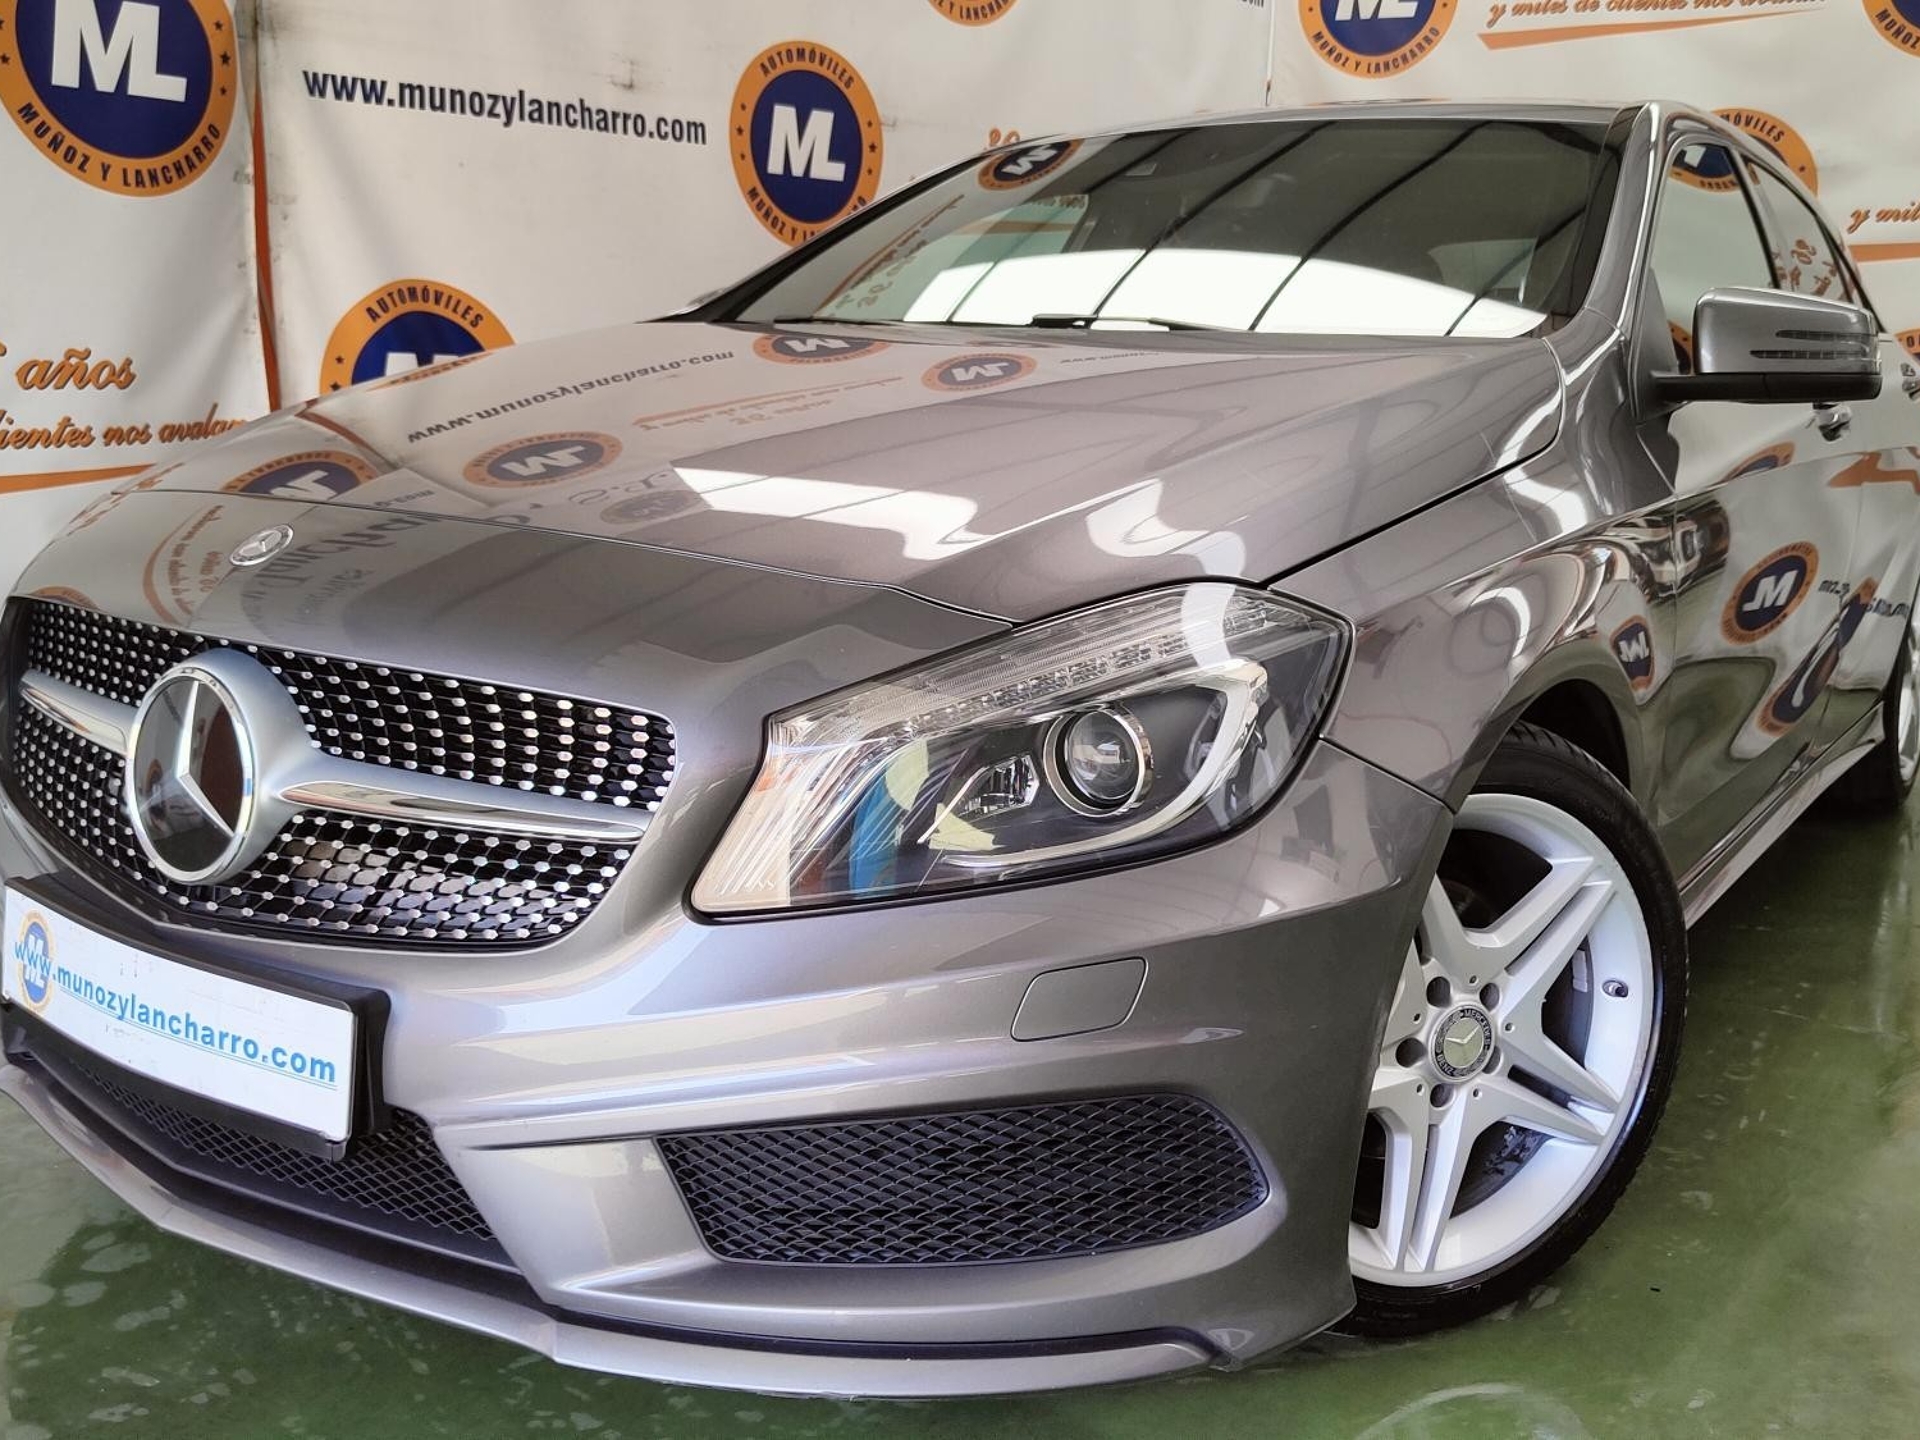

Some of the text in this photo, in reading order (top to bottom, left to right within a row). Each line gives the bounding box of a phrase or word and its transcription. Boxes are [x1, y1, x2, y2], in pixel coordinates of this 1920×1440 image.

[51, 0, 187, 102] ML
[759, 47, 855, 90] AUTOMÓVILES
[1312, 30, 1350, 67] MUÑOZ
[1366, 26, 1440, 74] LANCHARRO
[302, 70, 708, 145] www.munozylancharro.com
[1719, 111, 1785, 142] ÓVILES
[17, 102, 221, 188] MUÑOZ Y LANCHARRO
[767, 103, 846, 182] ML
[747, 186, 786, 236] MUÑOZ
[1846, 208, 1870, 234] y
[365, 284, 484, 329] AUTOMÓVILES
[16, 348, 137, 390] años
[0, 409, 96, 449] ientes
[102, 424, 152, 447] nos
[15, 941, 336, 1082] www.munozylancharro.com
